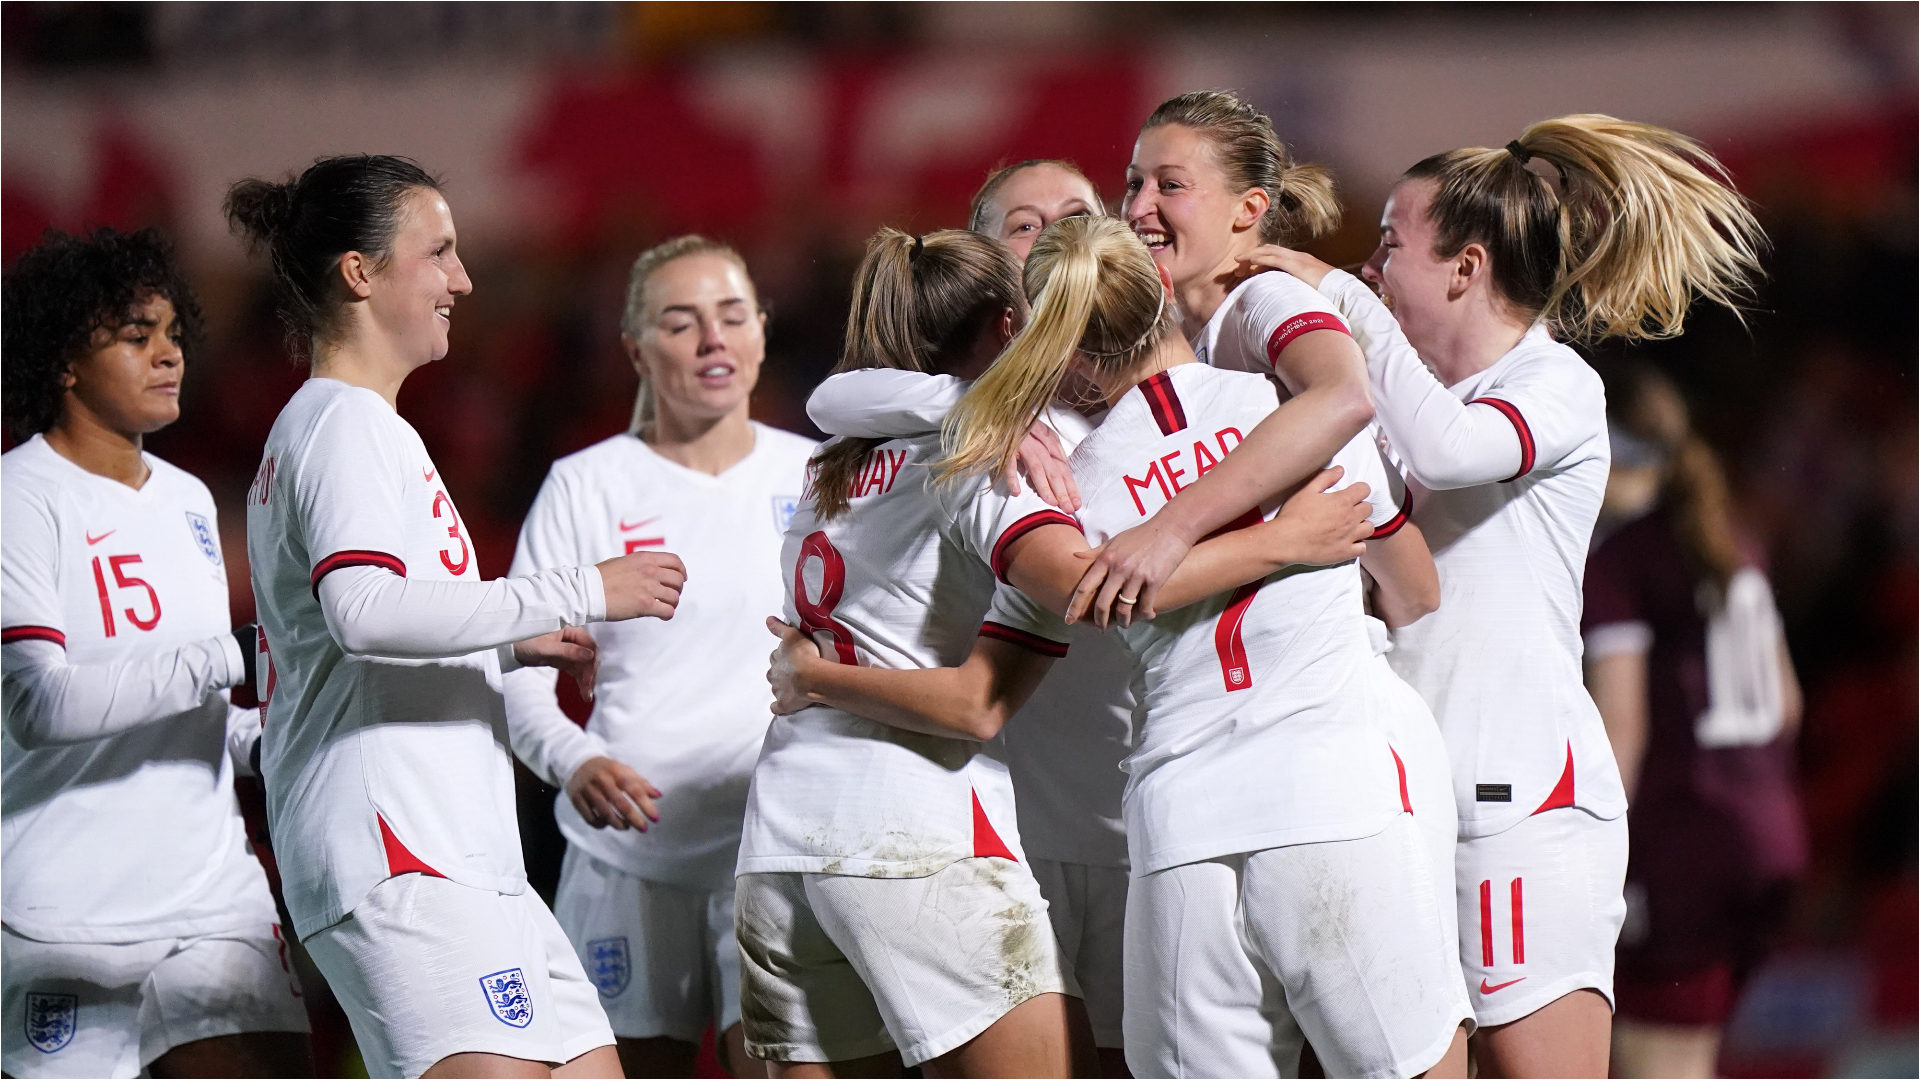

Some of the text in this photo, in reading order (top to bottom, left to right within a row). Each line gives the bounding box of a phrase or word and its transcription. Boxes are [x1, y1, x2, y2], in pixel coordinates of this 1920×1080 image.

[1278, 321, 1308, 341] NOVEMBER
[1283, 318, 1303, 332] LATVIA
[433, 489, 469, 576] 3
[92, 554, 162, 638] 15
[794, 530, 859, 667] 8
[1193, 505, 1265, 693] 7
[1693, 567, 1783, 748] 10
[1479, 876, 1525, 968] 11
